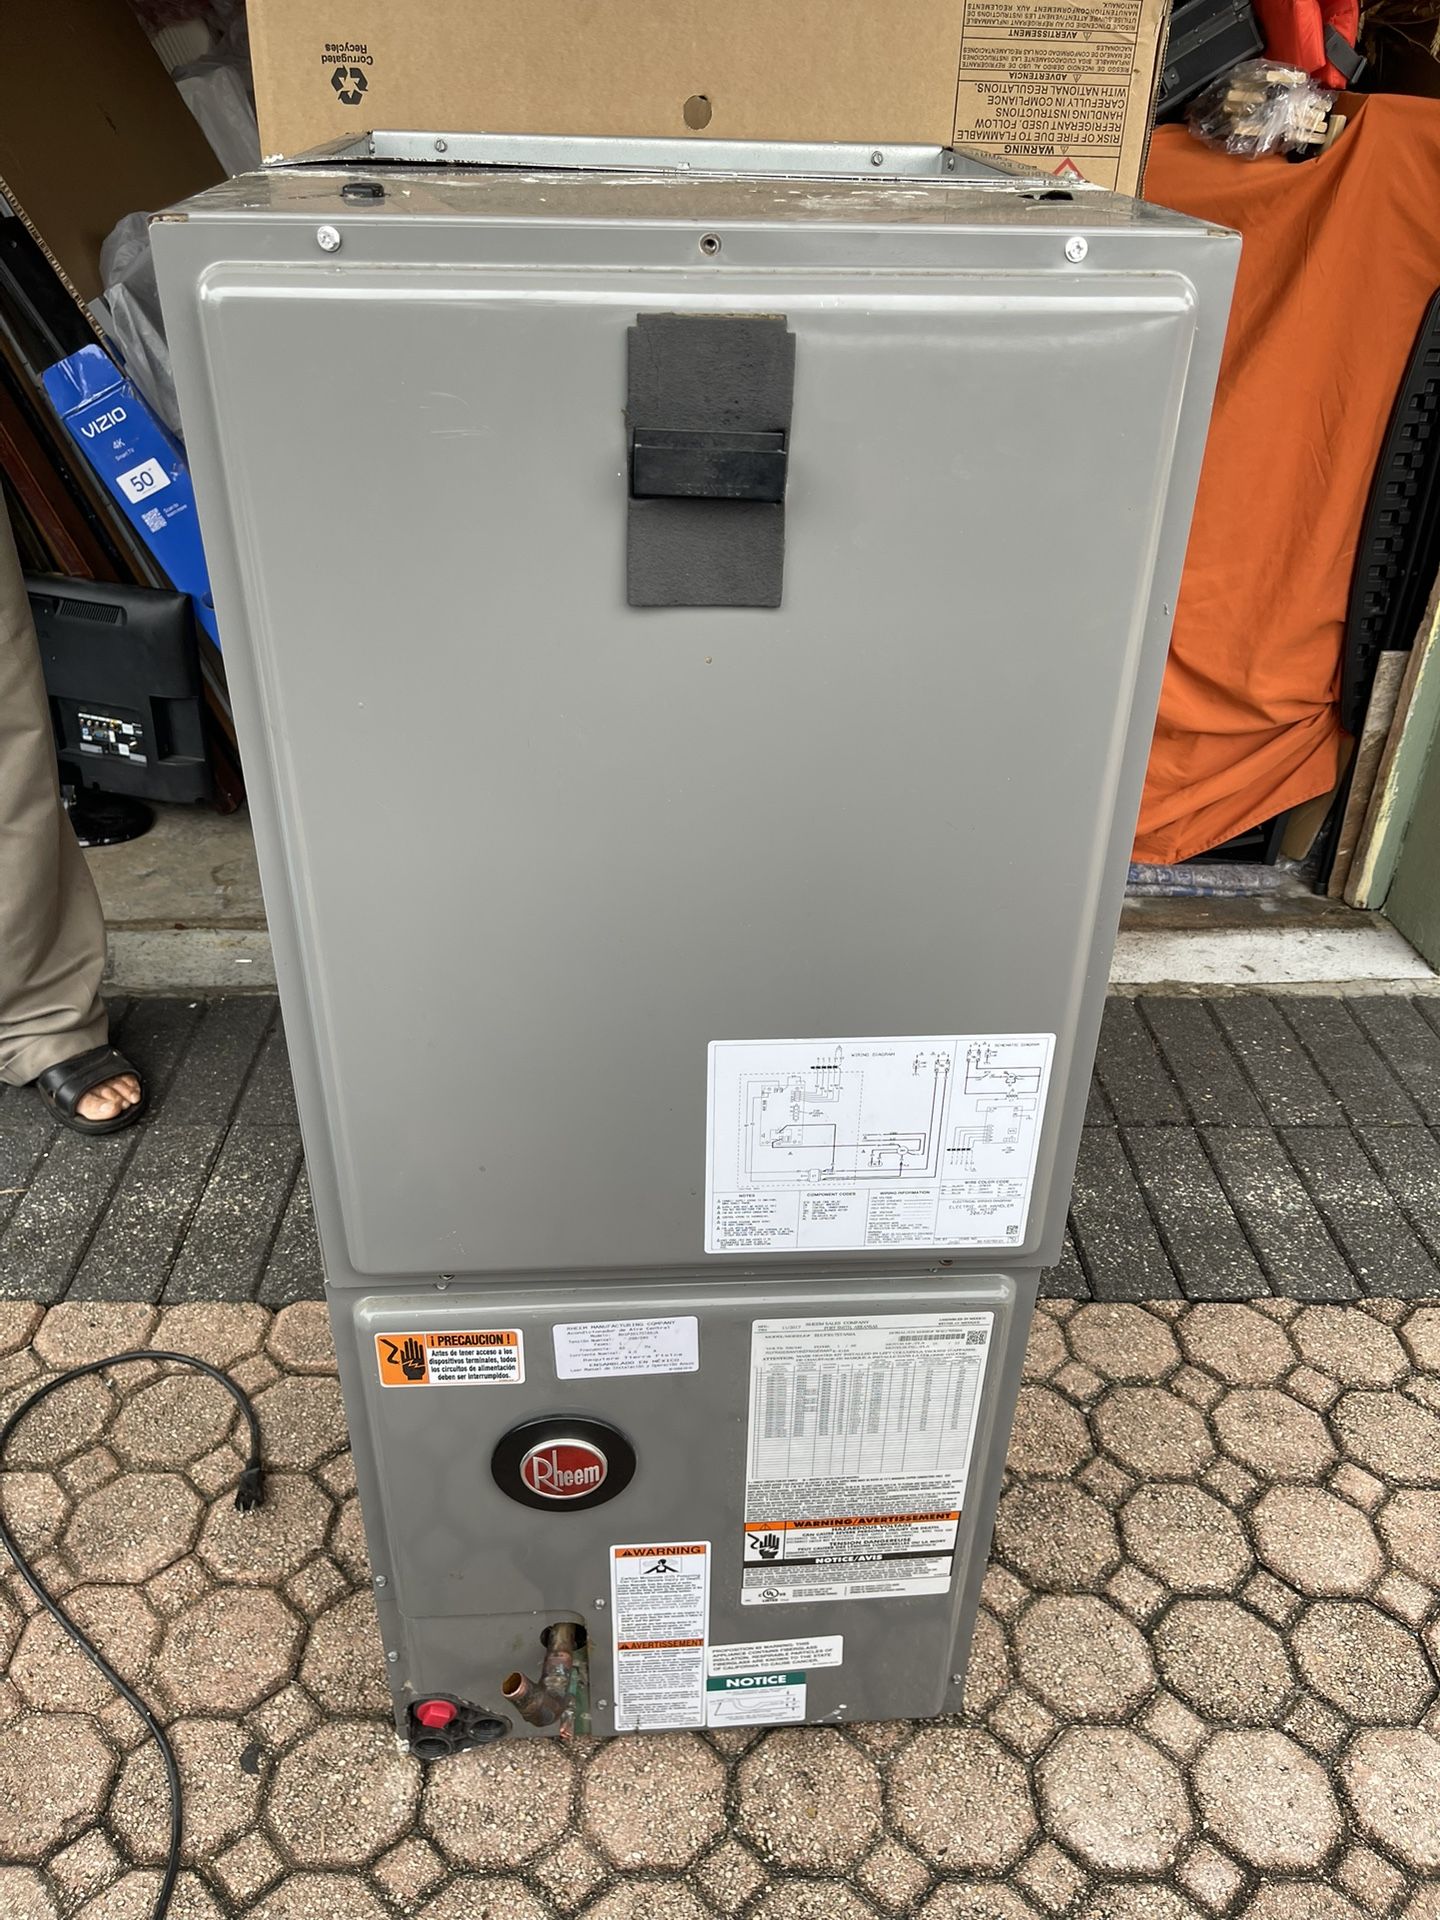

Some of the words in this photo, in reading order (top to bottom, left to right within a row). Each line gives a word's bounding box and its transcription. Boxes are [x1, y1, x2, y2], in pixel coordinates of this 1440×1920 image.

[1008, 29, 1078, 39] AVERTISSEMENT
[325, 42, 367, 54] Recycles
[963, 47, 1022, 55] REGLAMENTACIONES
[321, 53, 374, 65] Corrugated
[1024, 56, 1076, 64] CUIDADOSAMENTE
[1009, 72, 1067, 80] ADVERTENCIA
[974, 83, 1048, 94] REGULATIONS.
[1050, 86, 1099, 96] NATIONAL
[1101, 87, 1126, 97] WITH
[987, 95, 1053, 106] COMPLIANCE
[1055, 98, 1066, 107] IN
[1067, 98, 1125, 109] CAREFULLY
[995, 107, 1070, 118] INSTRUCTIONS
[1072, 110, 1123, 120] HANDLING
[974, 119, 1017, 129] FOLLOW
[1050, 121, 1121, 132] REFRIGERANT
[957, 130, 1017, 140] FLAMMABLE
[1018, 132, 1032, 141] TO
[1034, 132, 1055, 142] DUE
[1056, 133, 1079, 142] FIRE
[1081, 134, 1095, 143] OF
[1096, 134, 1120, 143] RISK
[1004, 145, 1055, 154] WARNING
[81, 407, 127, 438] VIZIO
[113, 438, 126, 449] 4K
[438, 1334, 503, 1346] PRECAUCION
[468, 1372, 511, 1380] interrumpidos.
[532, 1450, 600, 1492] Rheem
[793, 1513, 952, 1527] WARNING/AVERTISSEMENT
[633, 1546, 701, 1556] WARNING
[815, 1554, 883, 1564] NOTICE/AVIS
[631, 1639, 704, 1649] AVERTISSEMENT
[726, 1674, 787, 1688] NOTICE
